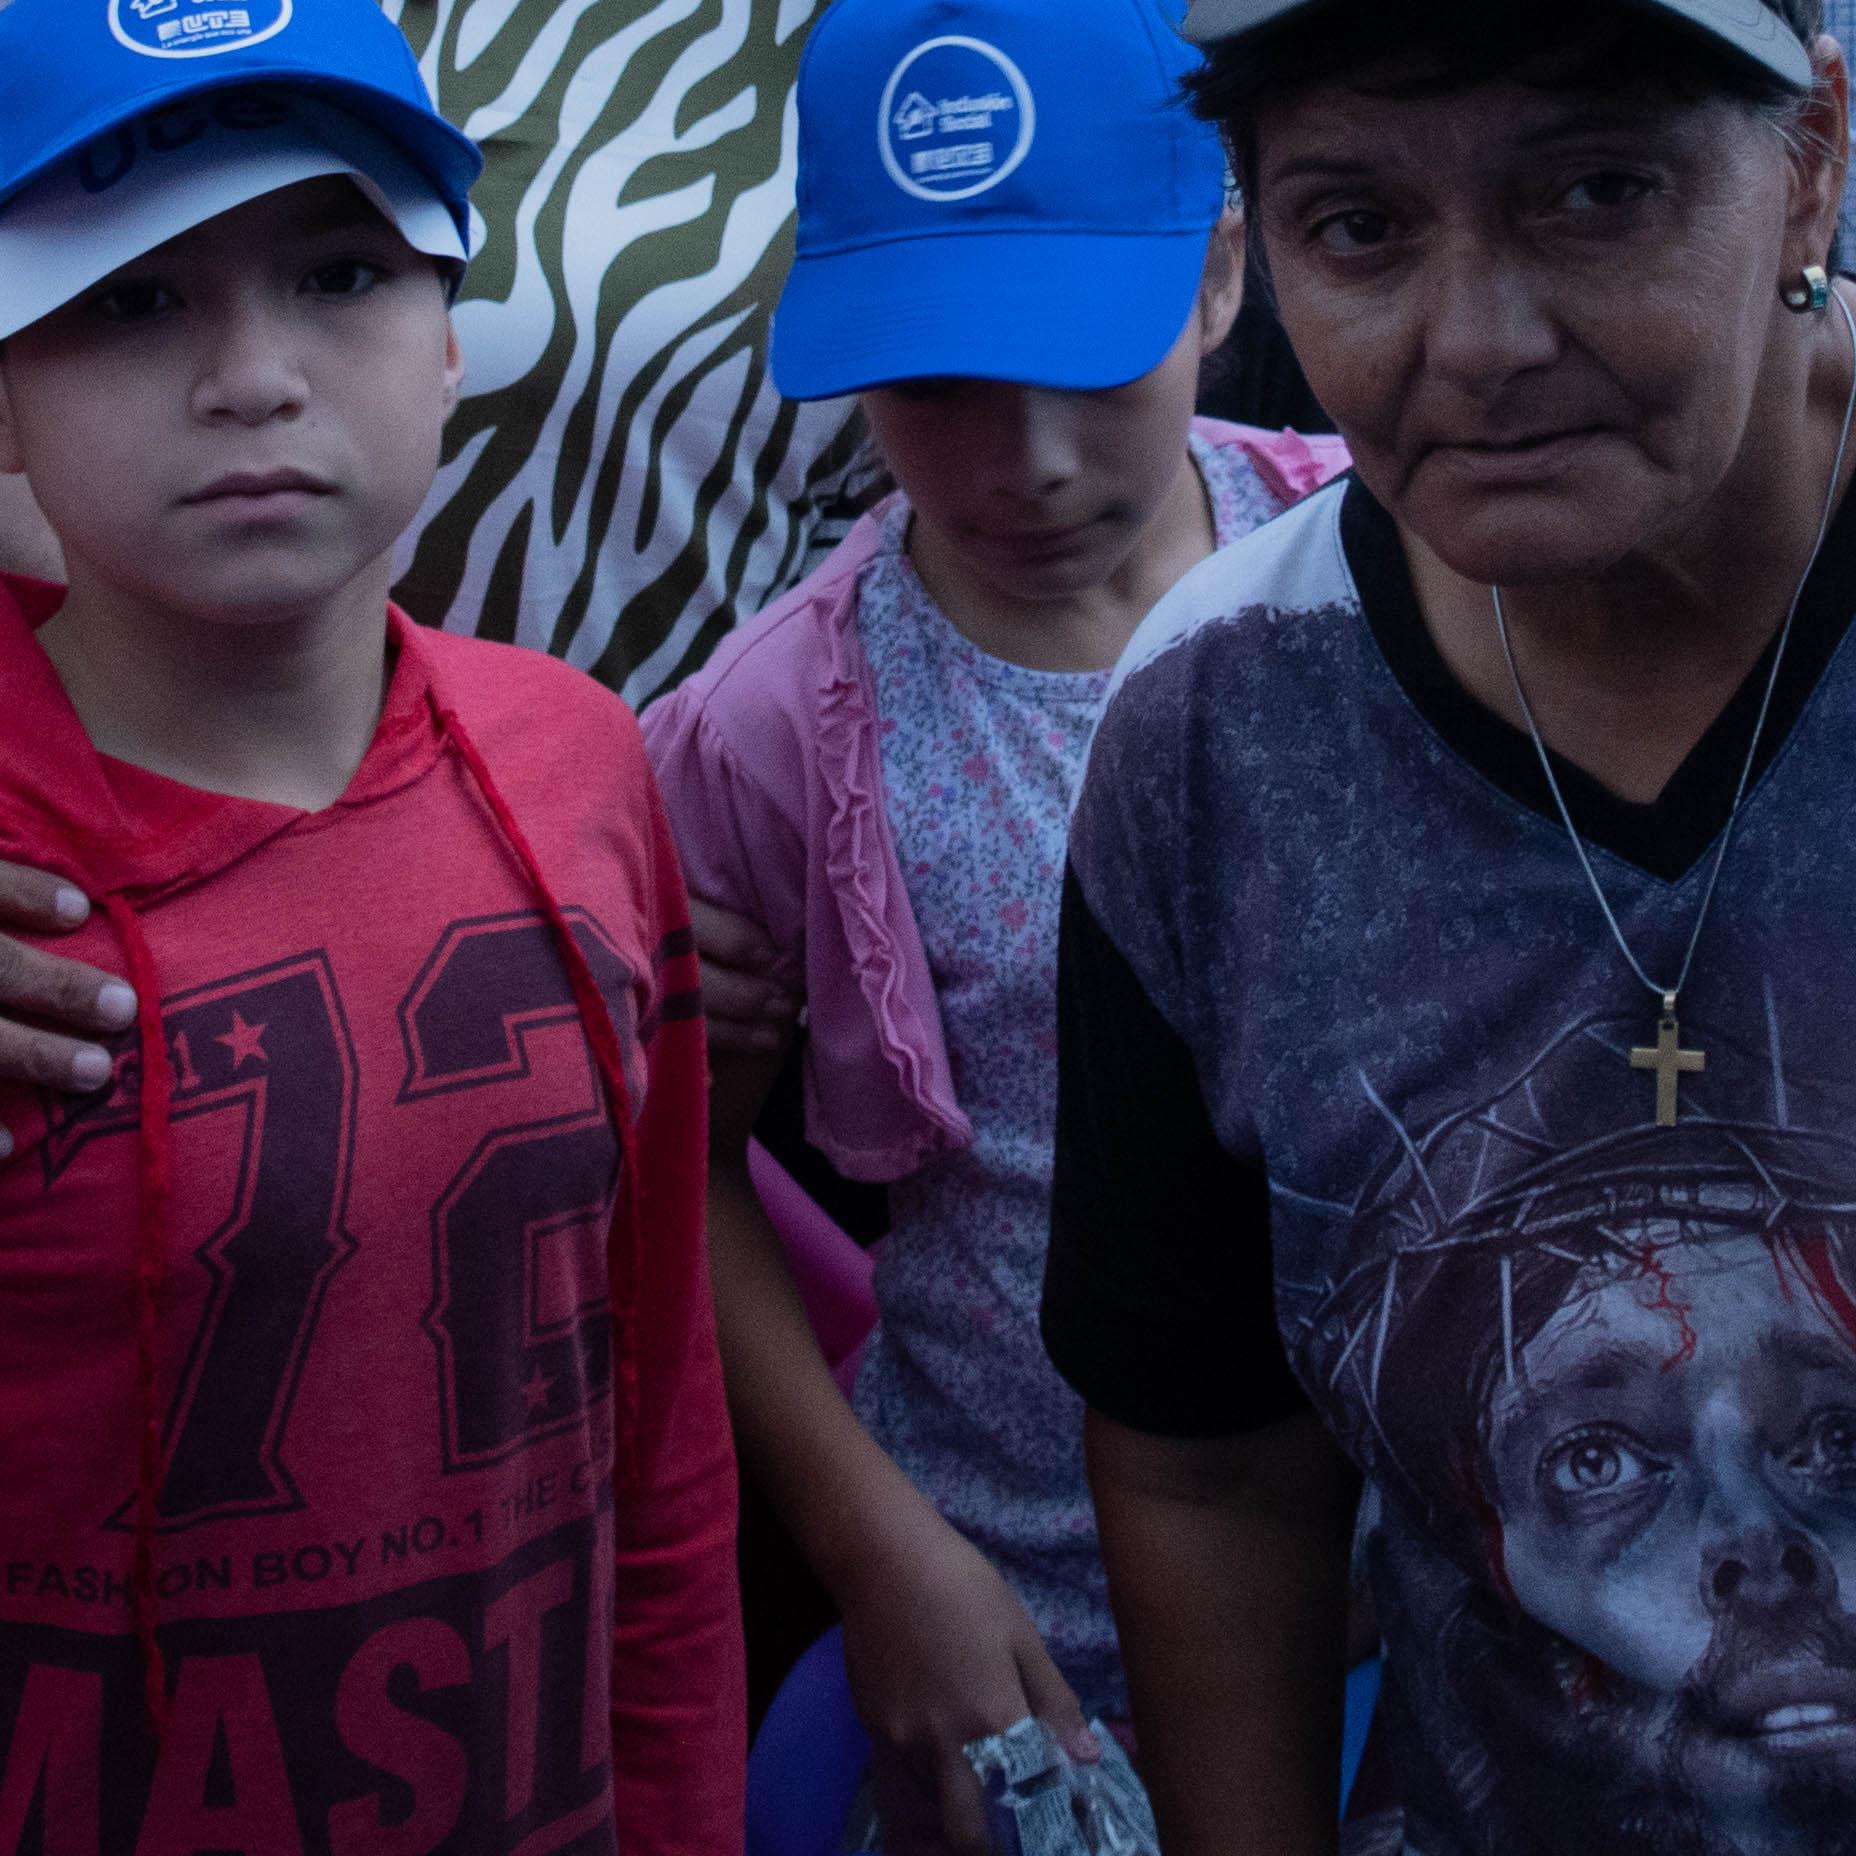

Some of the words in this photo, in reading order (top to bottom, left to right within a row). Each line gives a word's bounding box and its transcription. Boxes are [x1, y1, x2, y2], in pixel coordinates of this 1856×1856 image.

[181, 9, 251, 34] UTE
[4, 1555, 232, 1606] FASHON
[252, 1539, 365, 1588] BOY
